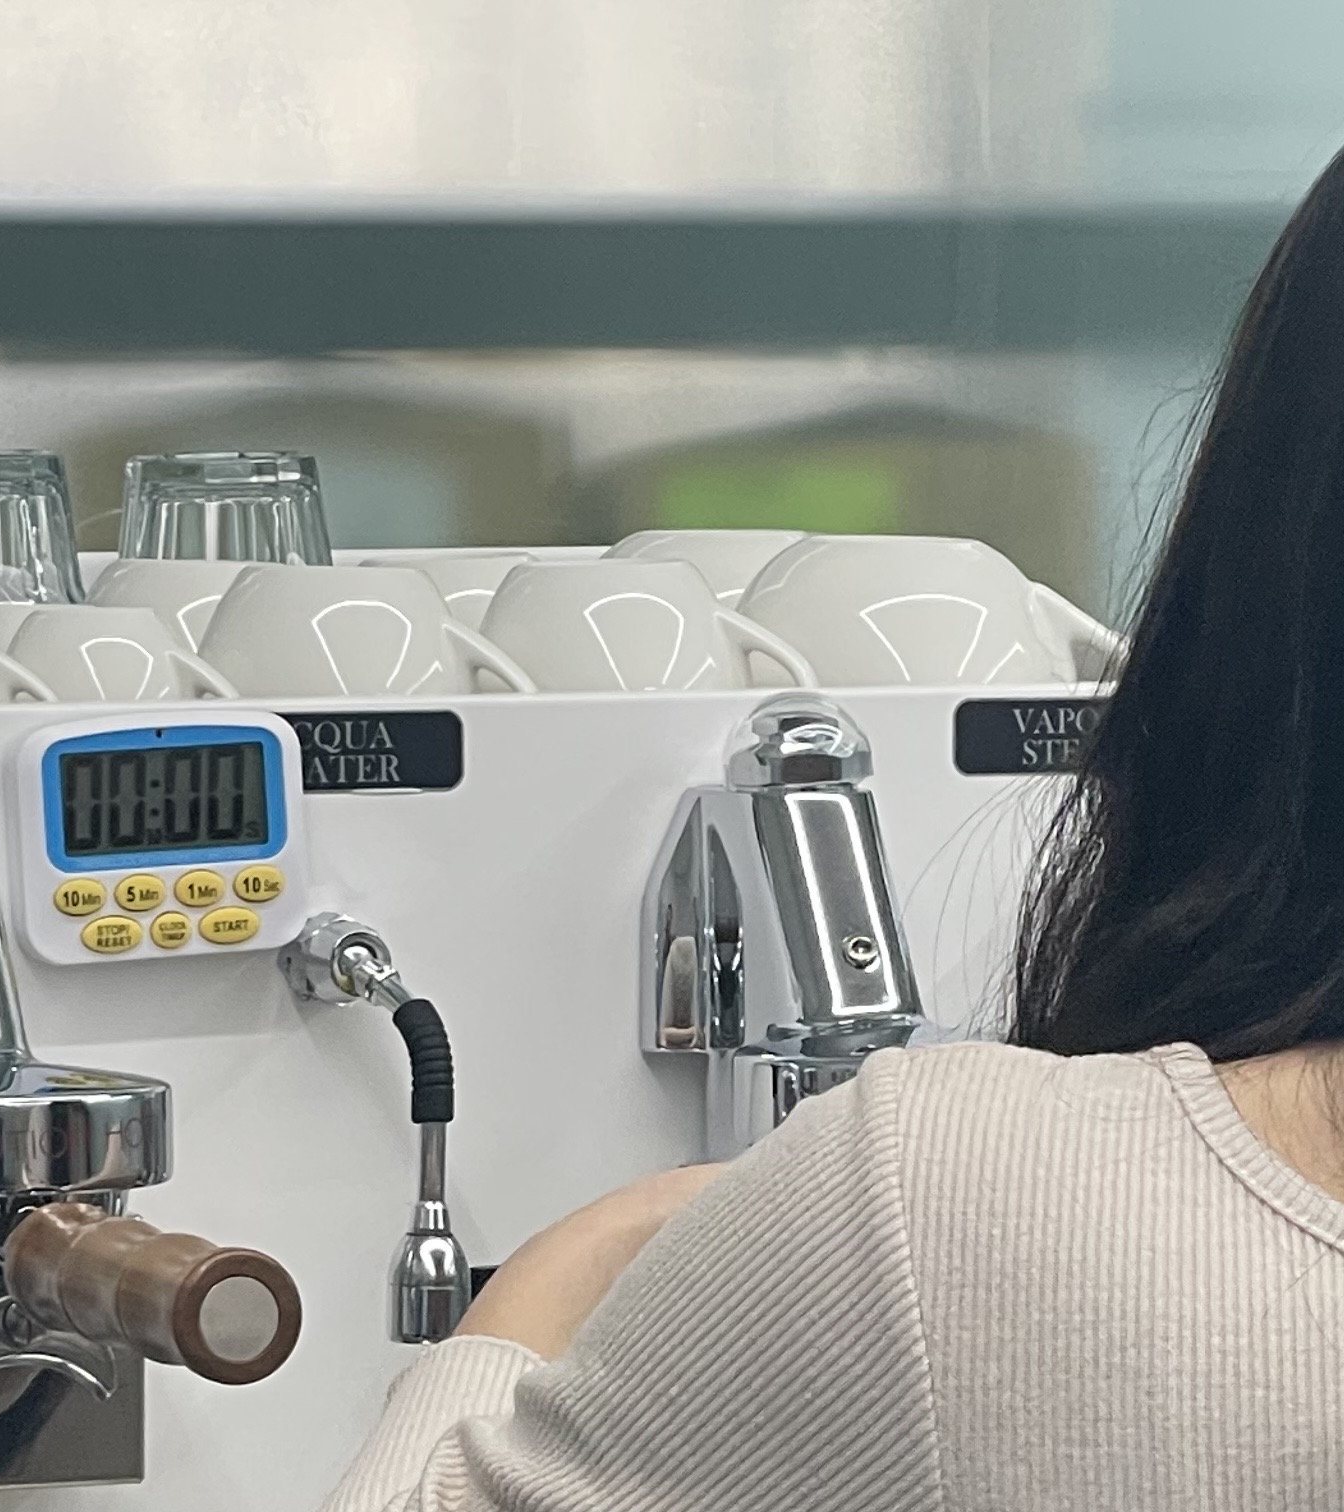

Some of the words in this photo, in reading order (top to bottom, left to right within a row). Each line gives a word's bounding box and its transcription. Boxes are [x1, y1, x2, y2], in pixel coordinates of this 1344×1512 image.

[1012, 708, 1099, 735] VAPO
[294, 720, 394, 754] CQUA
[1022, 739, 1080, 765] STE
[304, 754, 401, 784] ATER
[65, 749, 245, 850] 00:00
[126, 886, 136, 903] 5
[139, 888, 160, 902] Min
[187, 882, 196, 900] 1
[197, 885, 218, 899] Min
[243, 876, 261, 894] 10
[63, 890, 79, 907] 10
[82, 893, 101, 906] Min
[213, 918, 249, 933] START
